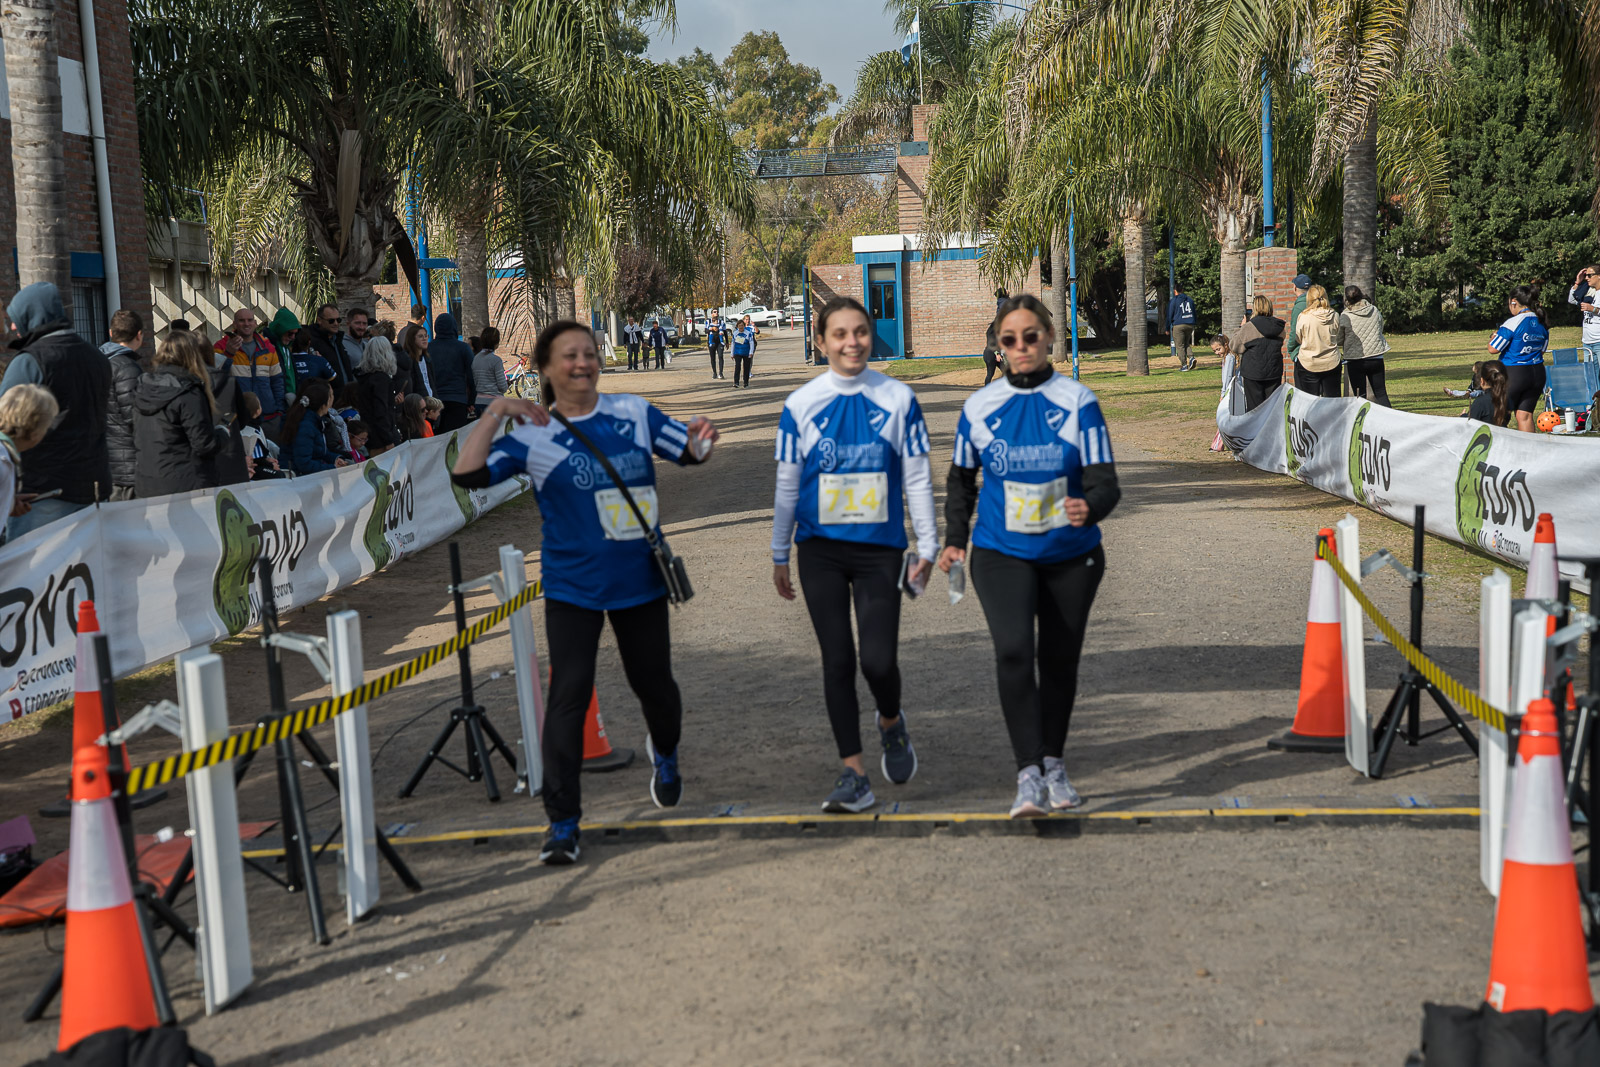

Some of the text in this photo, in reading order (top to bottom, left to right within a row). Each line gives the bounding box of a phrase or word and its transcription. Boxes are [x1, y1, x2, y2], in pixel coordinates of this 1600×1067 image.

[1179, 301, 1192, 314] 14
[818, 438, 837, 472] 3
[989, 438, 1008, 477] 3
[568, 452, 594, 490] 3
[605, 500, 651, 528] 712
[825, 488, 880, 512] 714
[1013, 494, 1060, 521] 721
